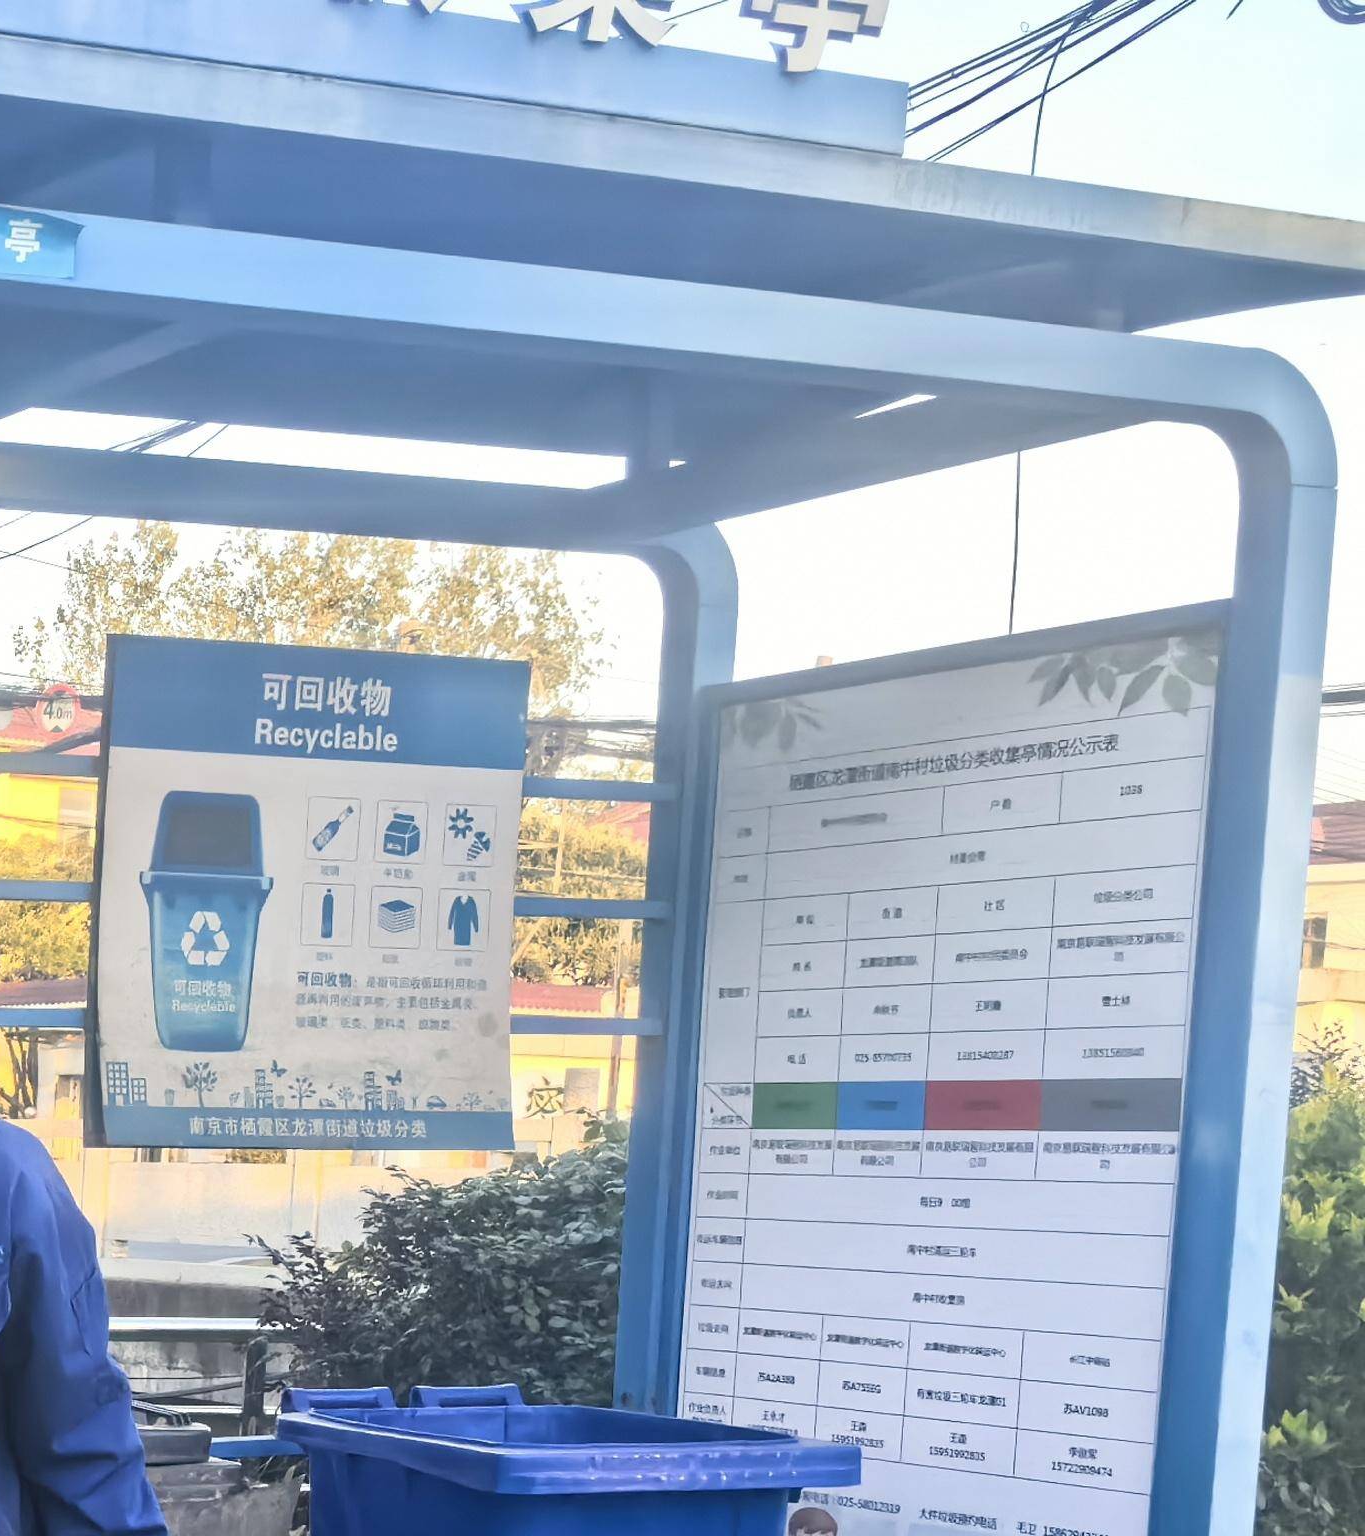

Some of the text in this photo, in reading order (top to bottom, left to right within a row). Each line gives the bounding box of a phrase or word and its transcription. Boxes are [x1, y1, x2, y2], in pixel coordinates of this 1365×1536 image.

[262, 671, 392, 718] 可回收物
[255, 717, 398, 753] Recyclable
[174, 979, 232, 998] 可回收物
[189, 1117, 427, 1138] 南京市栖霞区龙潭街道垃圾分类
